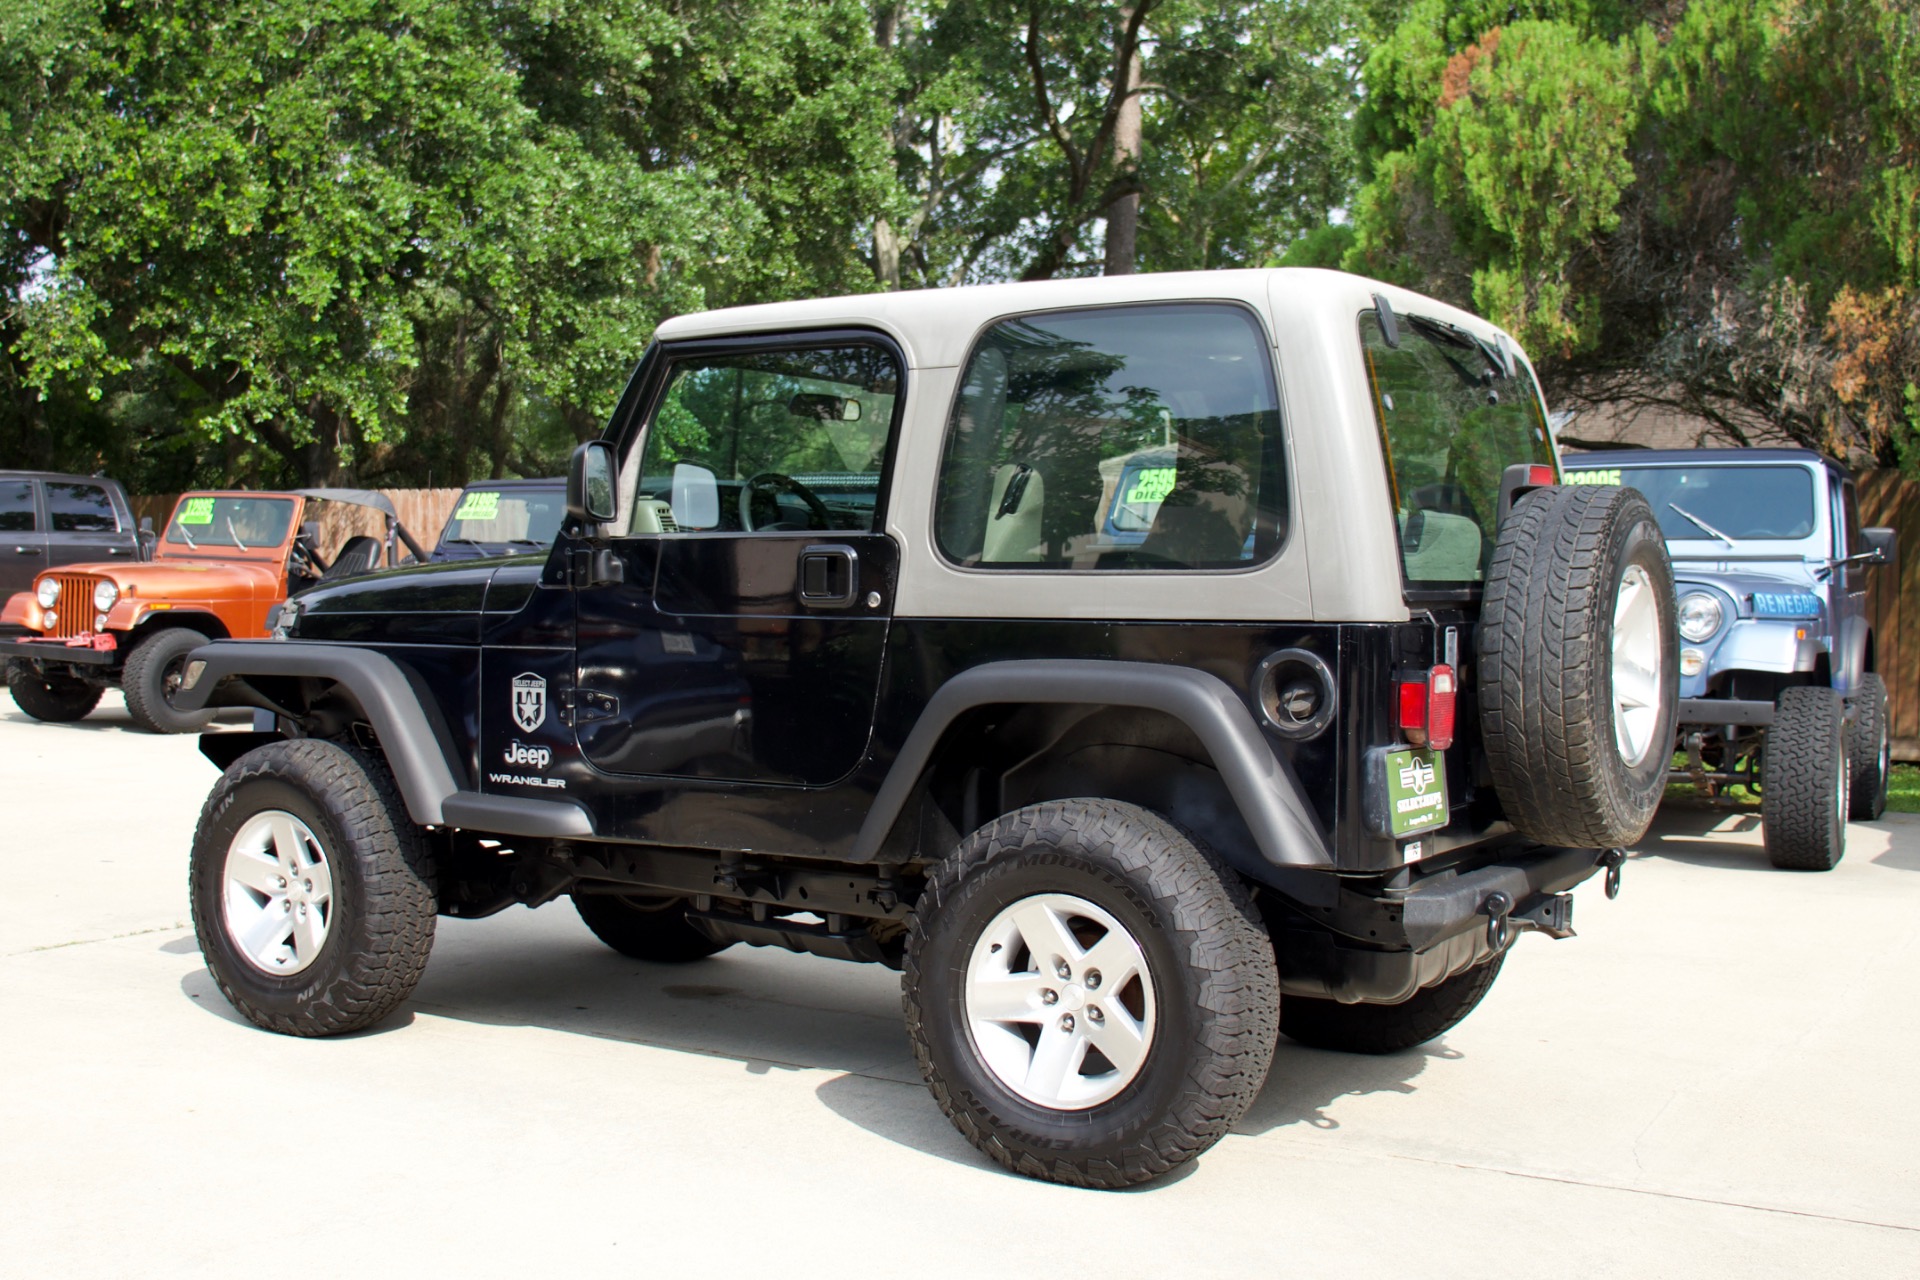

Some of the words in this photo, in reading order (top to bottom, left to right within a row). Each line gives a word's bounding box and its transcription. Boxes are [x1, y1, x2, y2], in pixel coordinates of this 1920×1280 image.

[504, 742, 550, 769] Jeep
[489, 773, 566, 788] WRANGLER
[1016, 852, 1166, 931] MOUNTAIN
